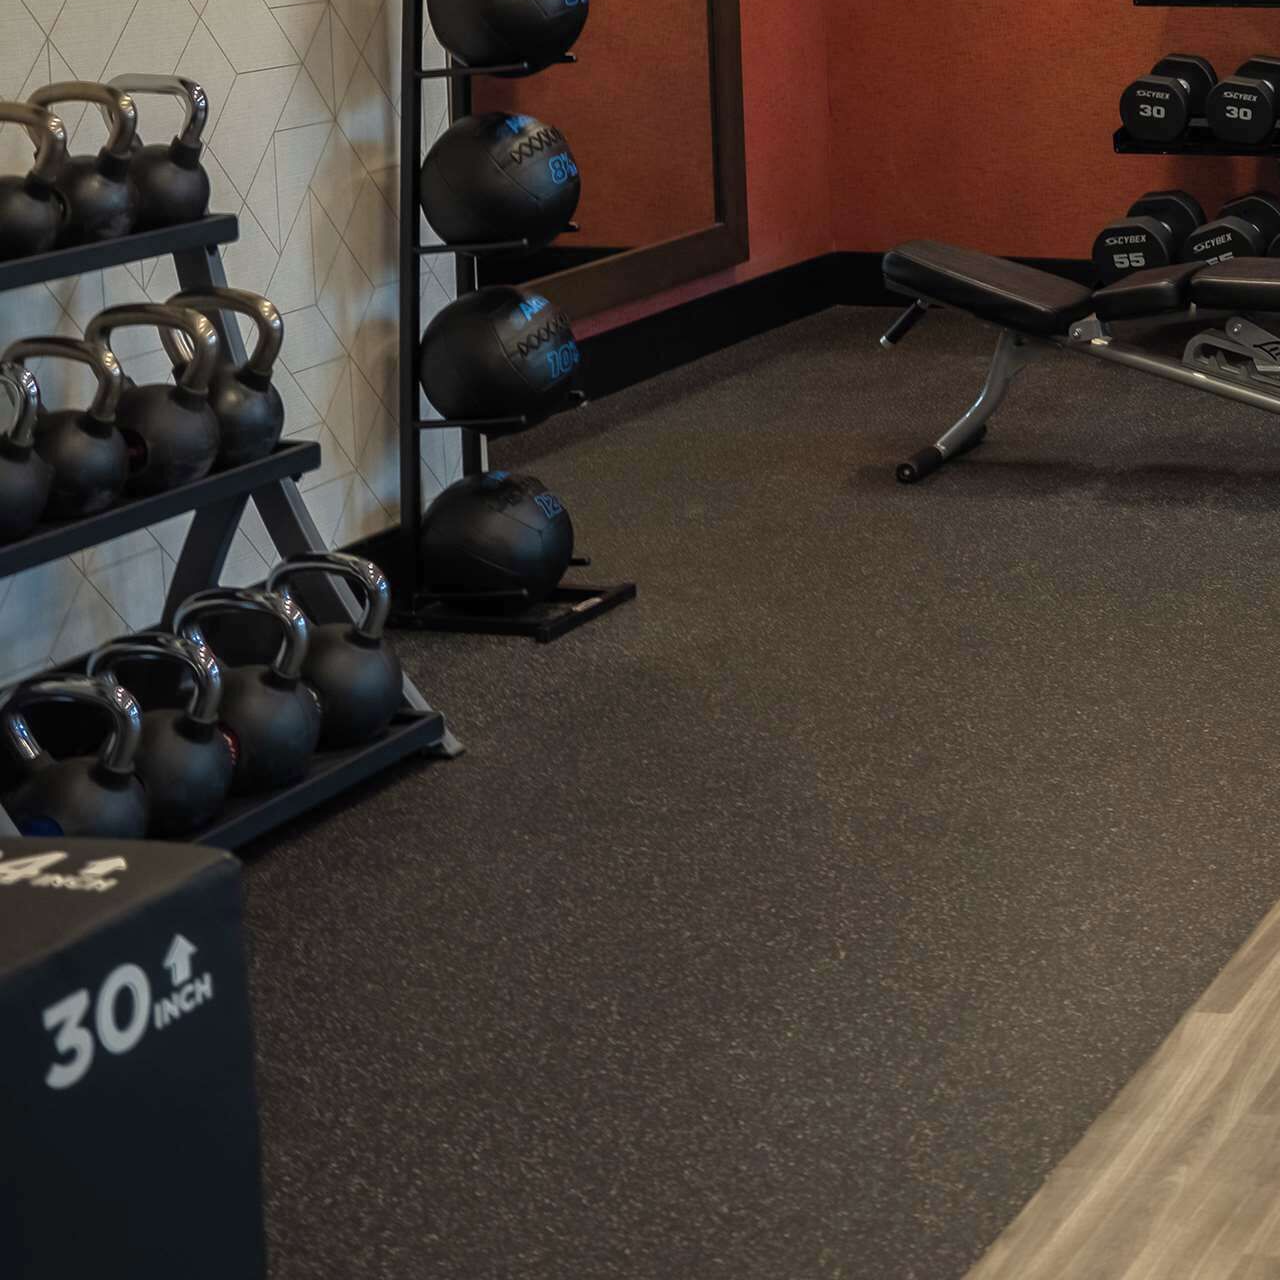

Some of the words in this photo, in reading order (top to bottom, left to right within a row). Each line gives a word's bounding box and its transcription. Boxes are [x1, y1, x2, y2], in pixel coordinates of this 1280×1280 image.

[1140, 105, 1165, 118] 30
[1226, 106, 1252, 120] 30
[1113, 253, 1145, 268] 55
[43, 962, 152, 1091] 30
[154, 972, 214, 1030] INCH
